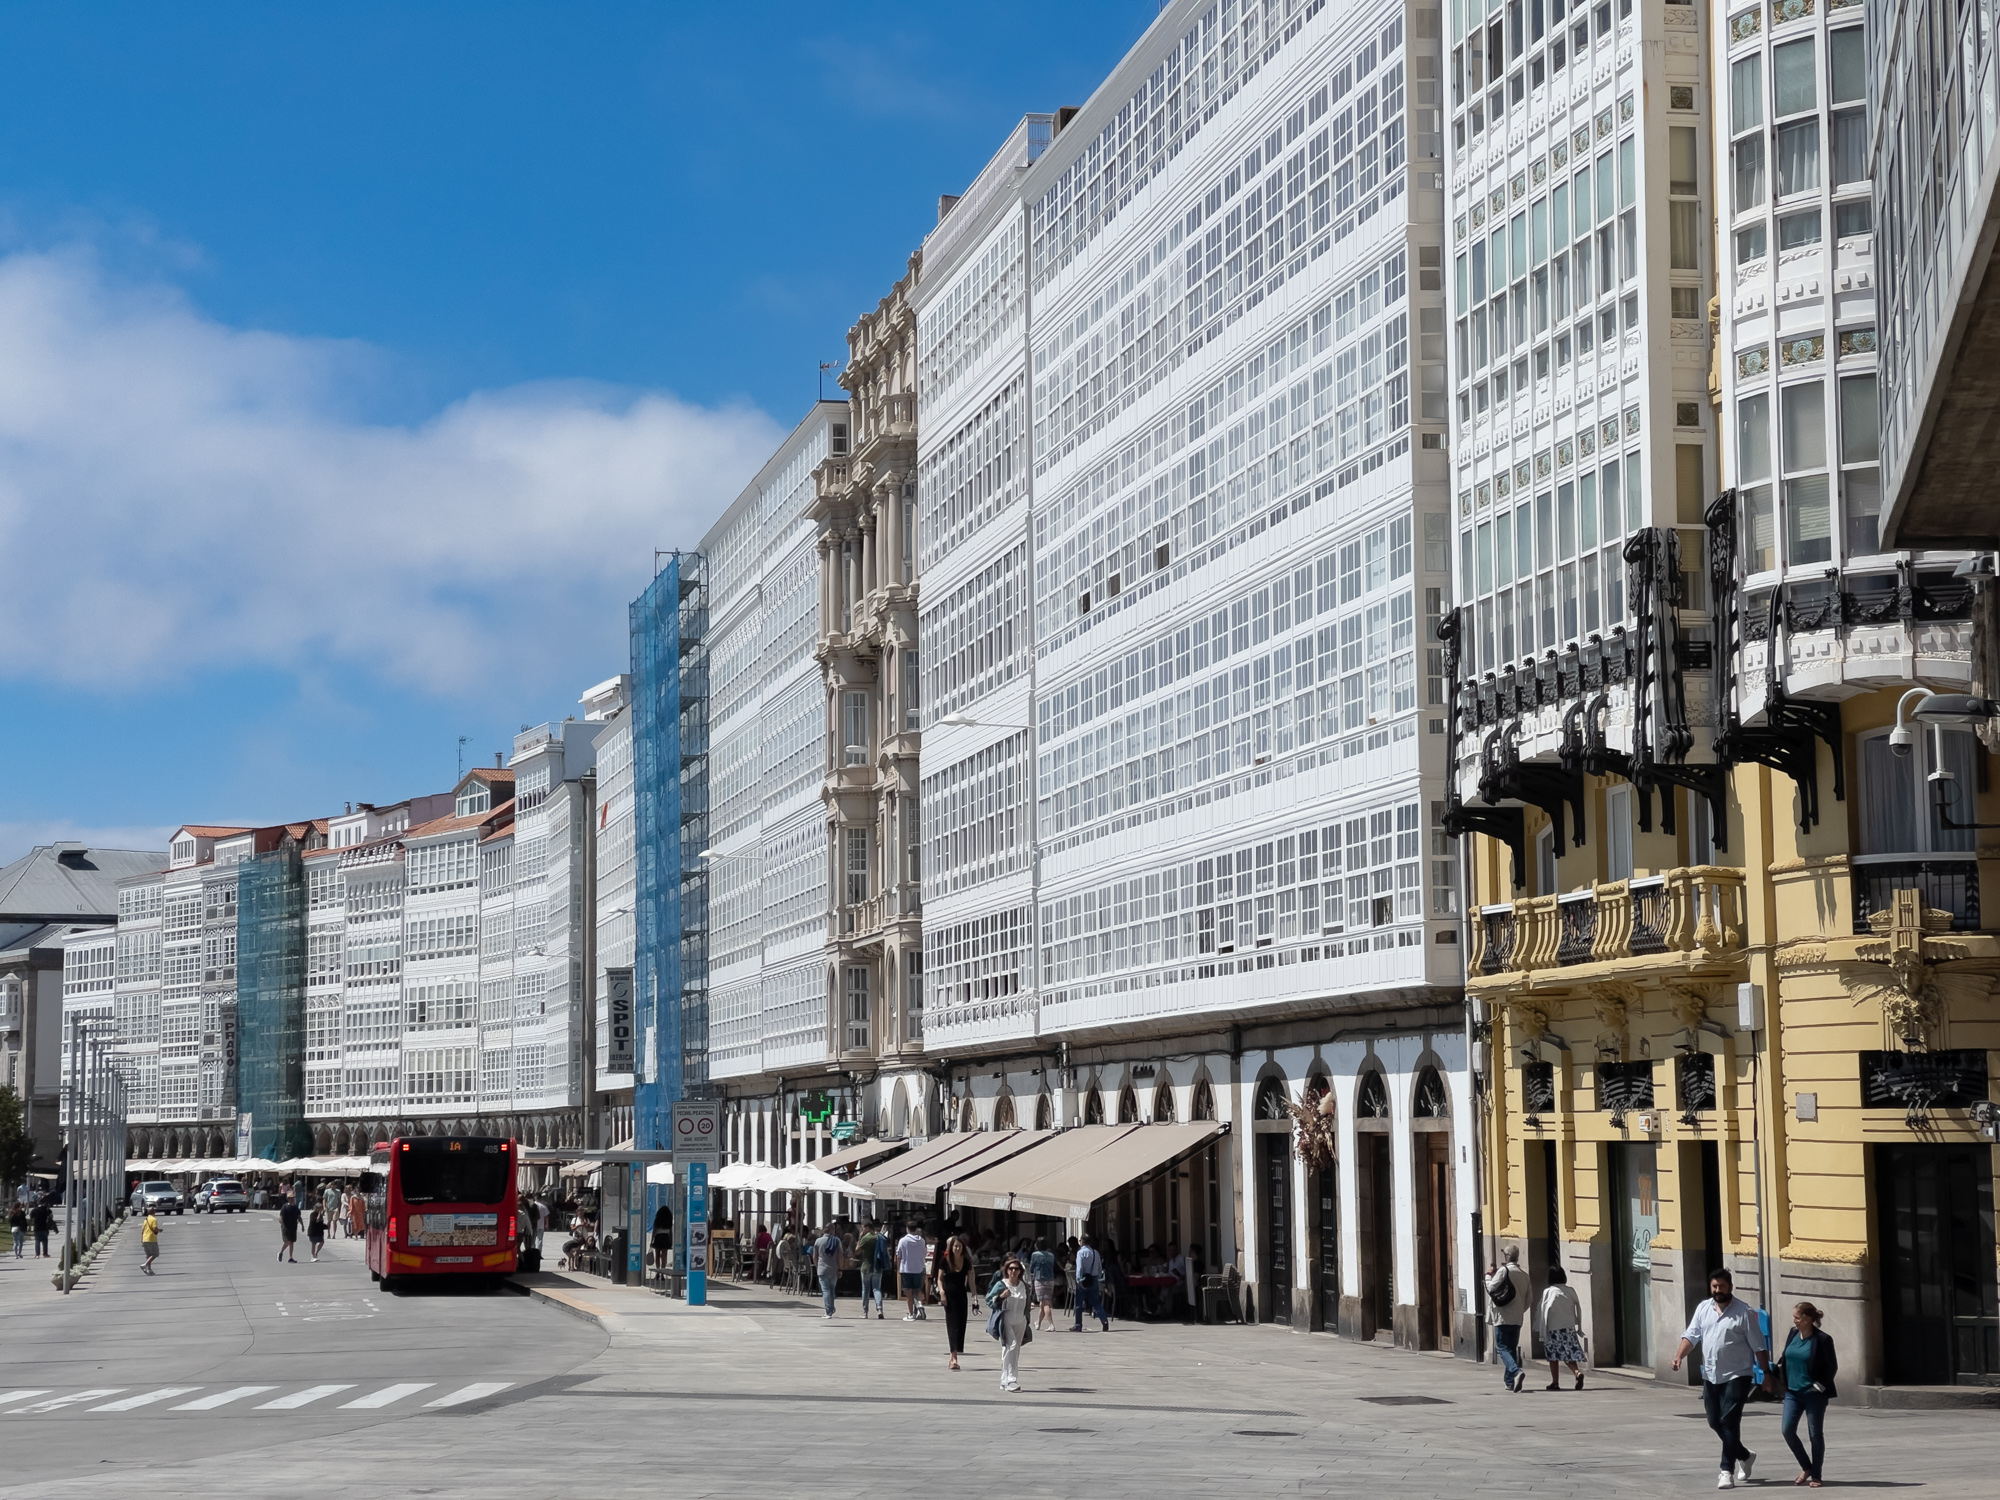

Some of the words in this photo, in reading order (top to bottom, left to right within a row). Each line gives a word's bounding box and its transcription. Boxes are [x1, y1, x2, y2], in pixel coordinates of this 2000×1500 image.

[613, 999, 629, 1051] SPOT
[225, 1022, 235, 1067] PRADO
[449, 1141, 461, 1151] 1A
[483, 1145, 498, 1154] 405
